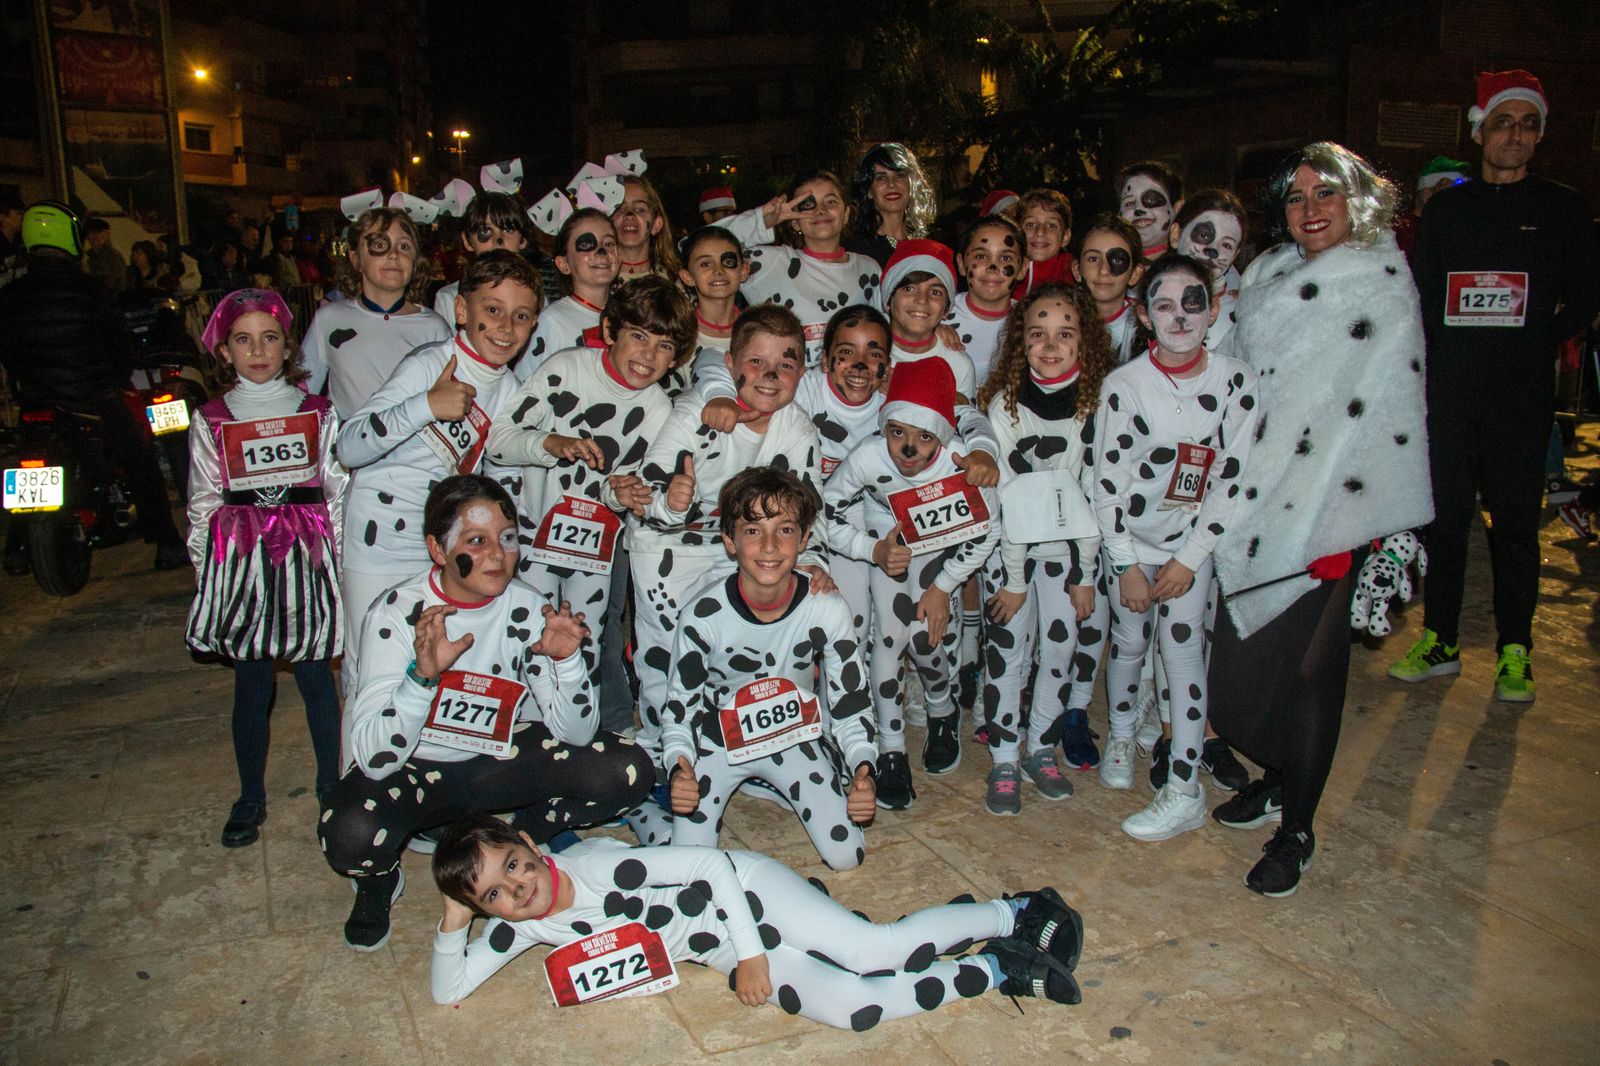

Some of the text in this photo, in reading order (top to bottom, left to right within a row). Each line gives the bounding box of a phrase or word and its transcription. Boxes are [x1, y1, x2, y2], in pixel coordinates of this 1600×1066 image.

[1461, 294, 1510, 308] 1275
[154, 403, 184, 417] 9463
[157, 417, 180, 429] LPH
[244, 441, 307, 465] 1363
[18, 469, 60, 487] 3826
[913, 499, 970, 530] 1276
[551, 522, 601, 548] 1271
[440, 698, 498, 727] 1277
[740, 699, 800, 733] 1689
[580, 939, 593, 953] SAN
[574, 953, 649, 992] 1272
